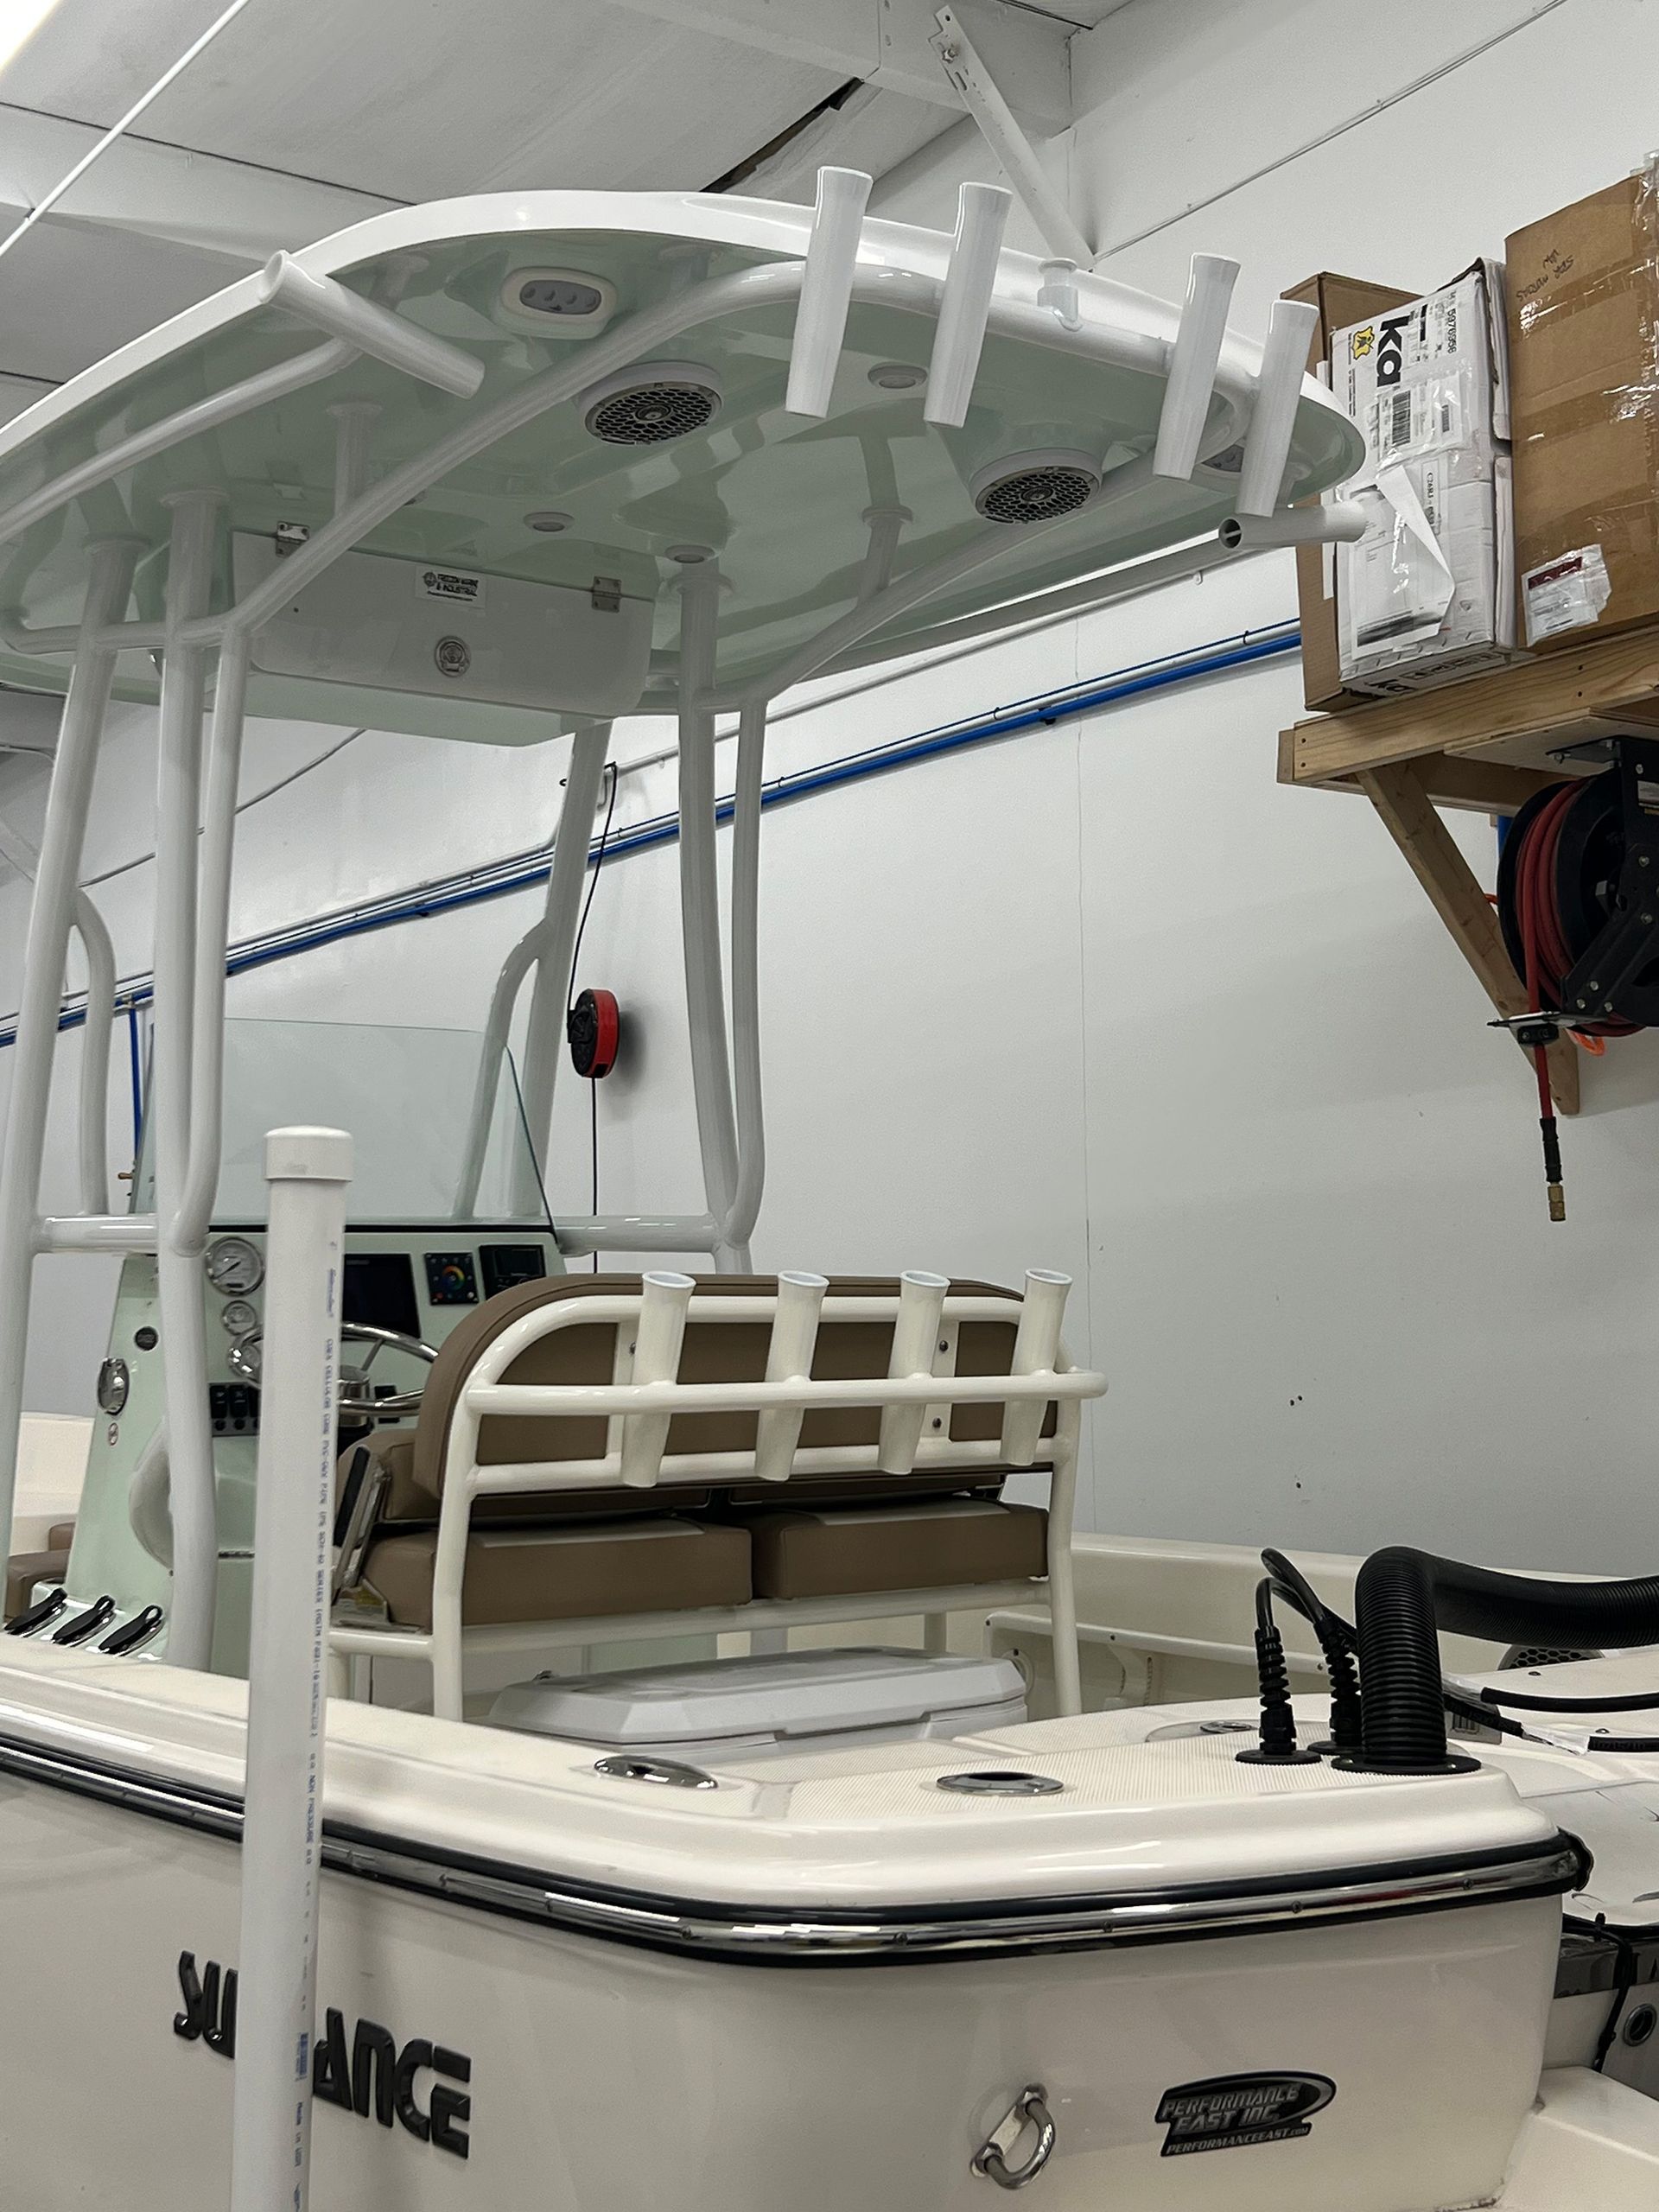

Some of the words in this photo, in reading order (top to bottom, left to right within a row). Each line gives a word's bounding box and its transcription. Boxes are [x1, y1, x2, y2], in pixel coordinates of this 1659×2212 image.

[306, 1797, 315, 1844] PRESSURE
[173, 1949, 473, 2160] SUANCE
[1161, 2082, 1301, 2118] PERFORMANCE
[1173, 2109, 1236, 2133] EAST
